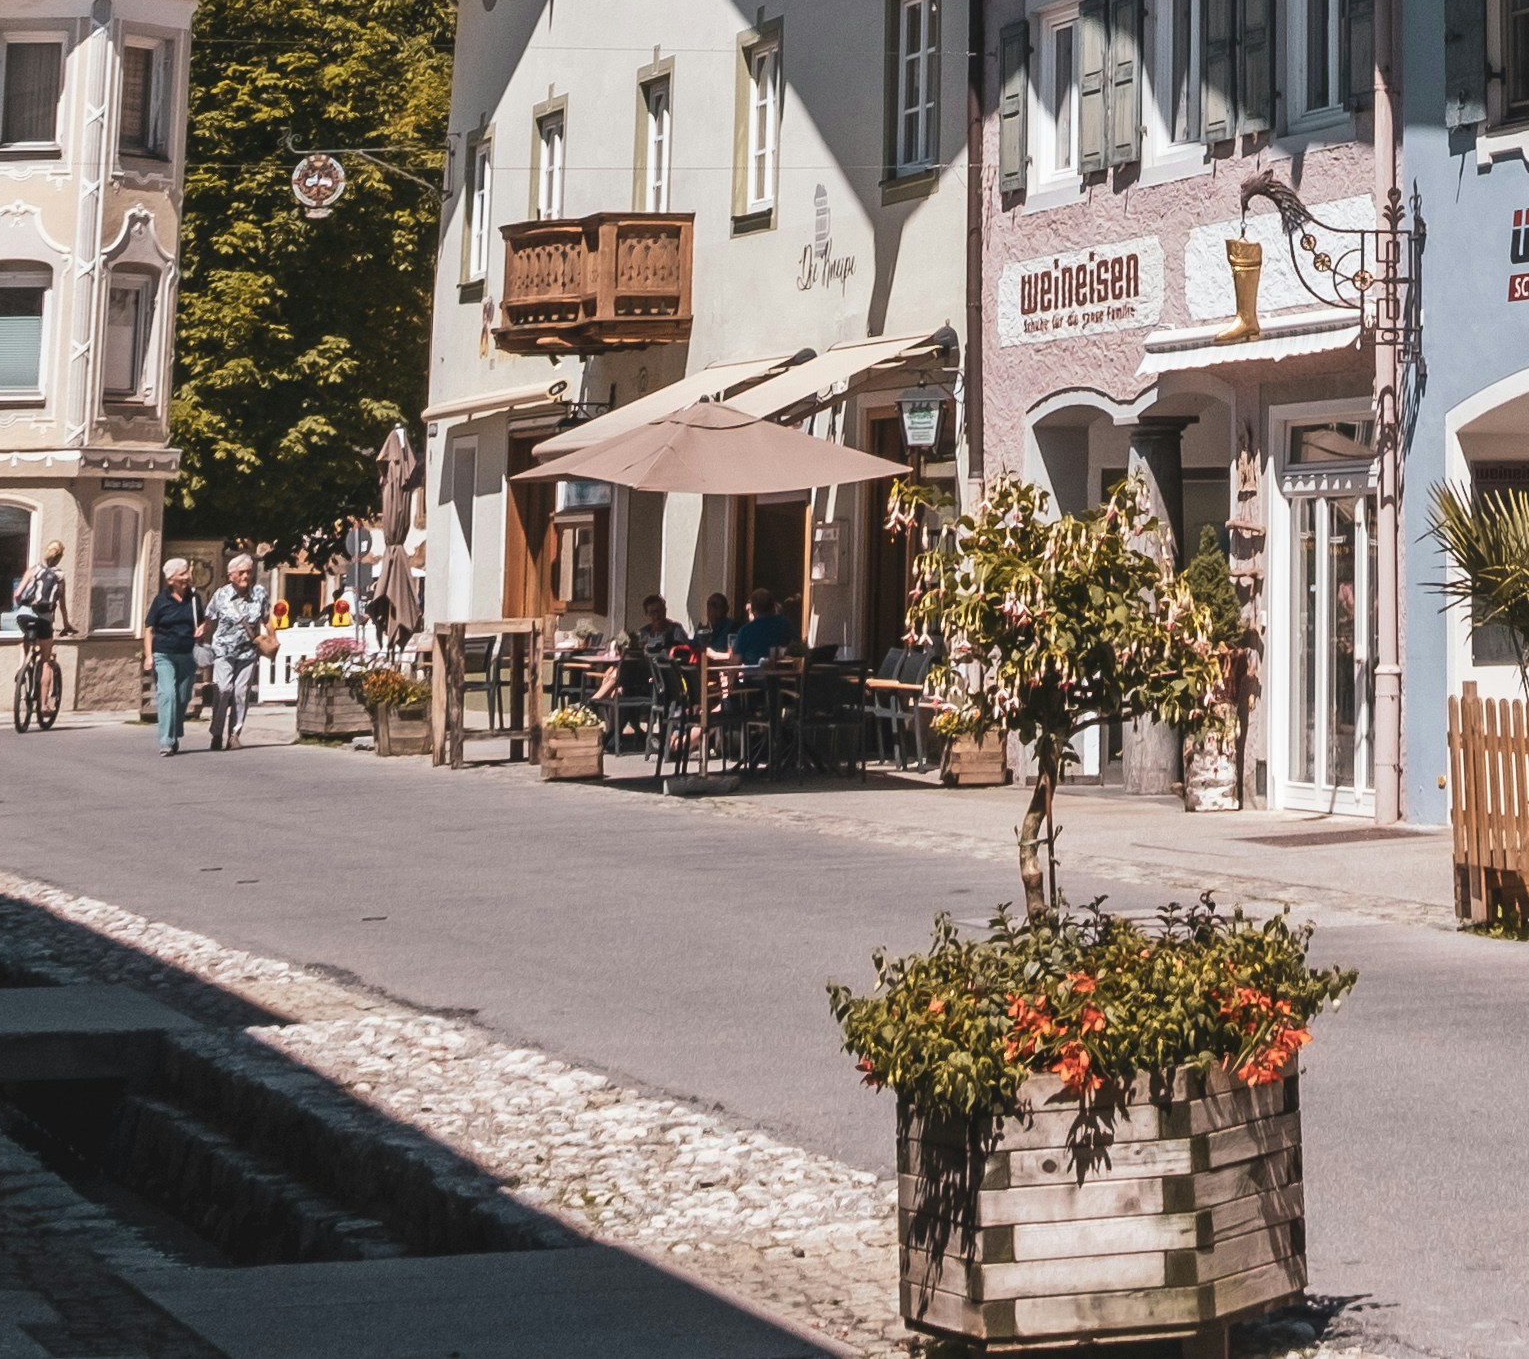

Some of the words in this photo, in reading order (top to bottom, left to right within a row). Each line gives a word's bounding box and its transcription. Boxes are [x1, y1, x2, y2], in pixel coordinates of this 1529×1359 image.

[796, 243, 820, 291] Die
[821, 237, 856, 297] Kneipe
[1020, 251, 1140, 315] weineisen
